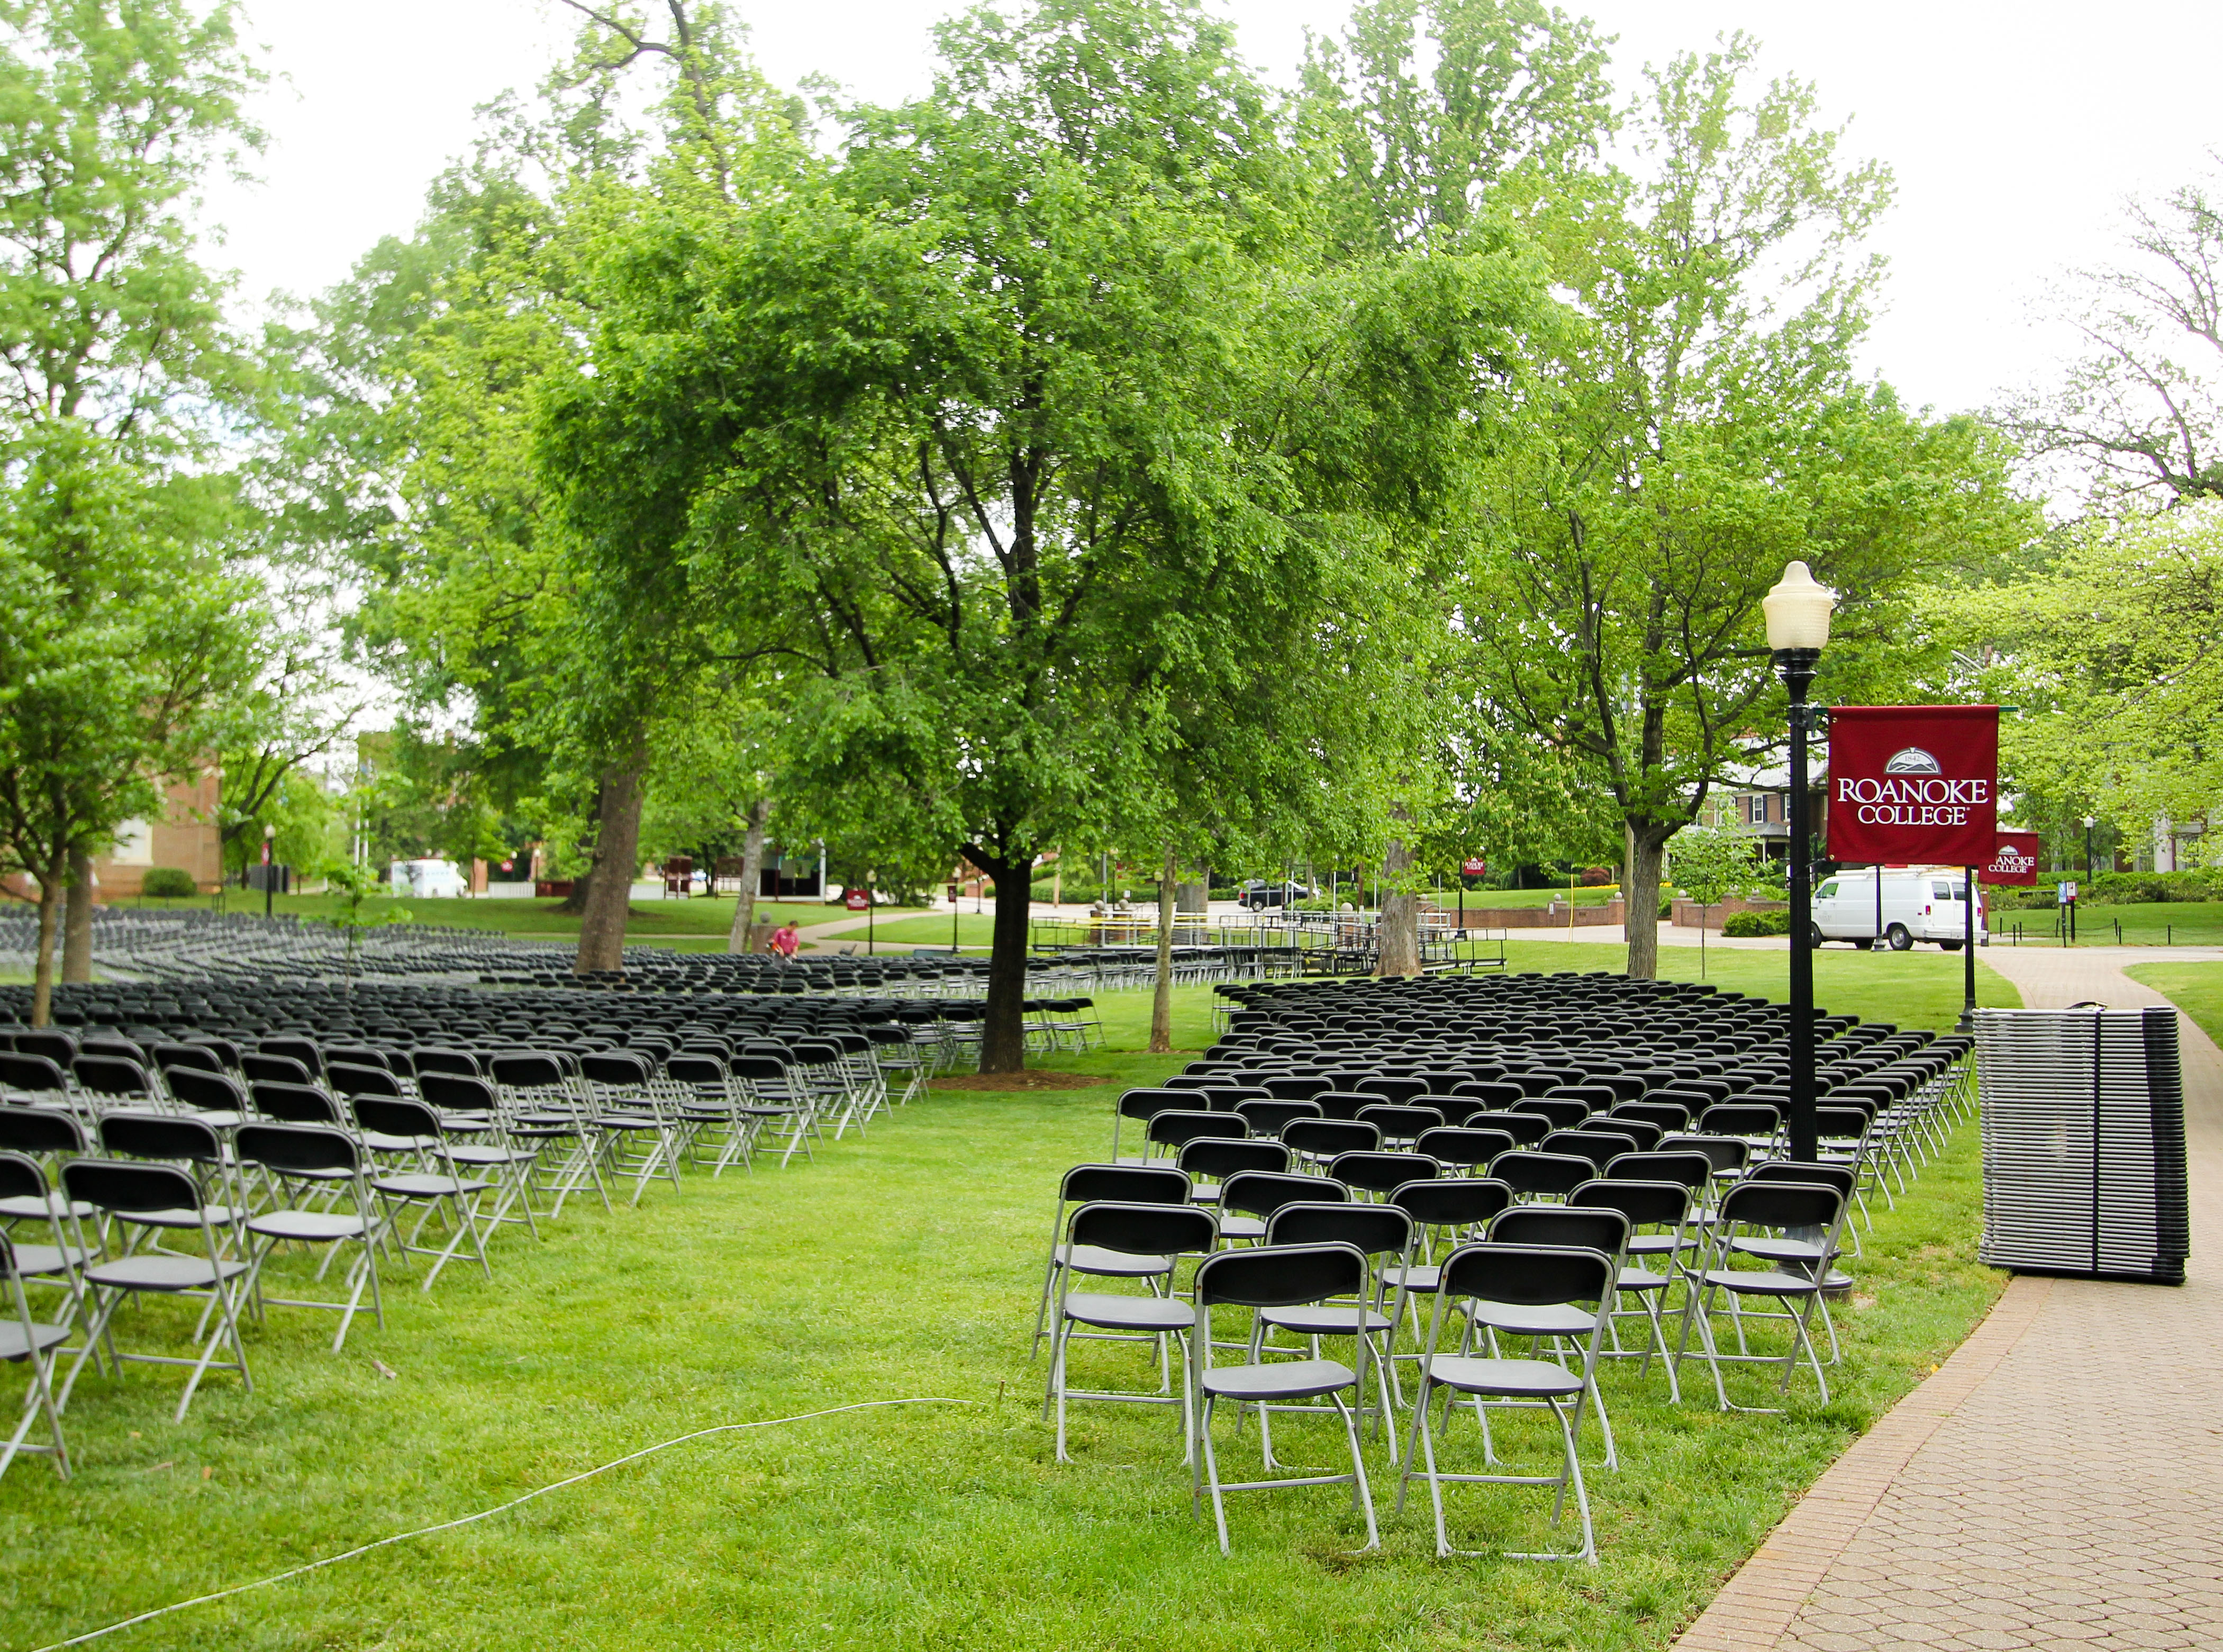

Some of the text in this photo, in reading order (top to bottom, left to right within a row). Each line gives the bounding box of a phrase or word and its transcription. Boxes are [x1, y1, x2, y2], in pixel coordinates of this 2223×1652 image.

[1837, 778, 1989, 803] ROANOKE
[1858, 805, 1967, 825] COLLEGE
[1988, 864, 2027, 873] COLLEGE
[1996, 856, 2035, 866] ANOKE
